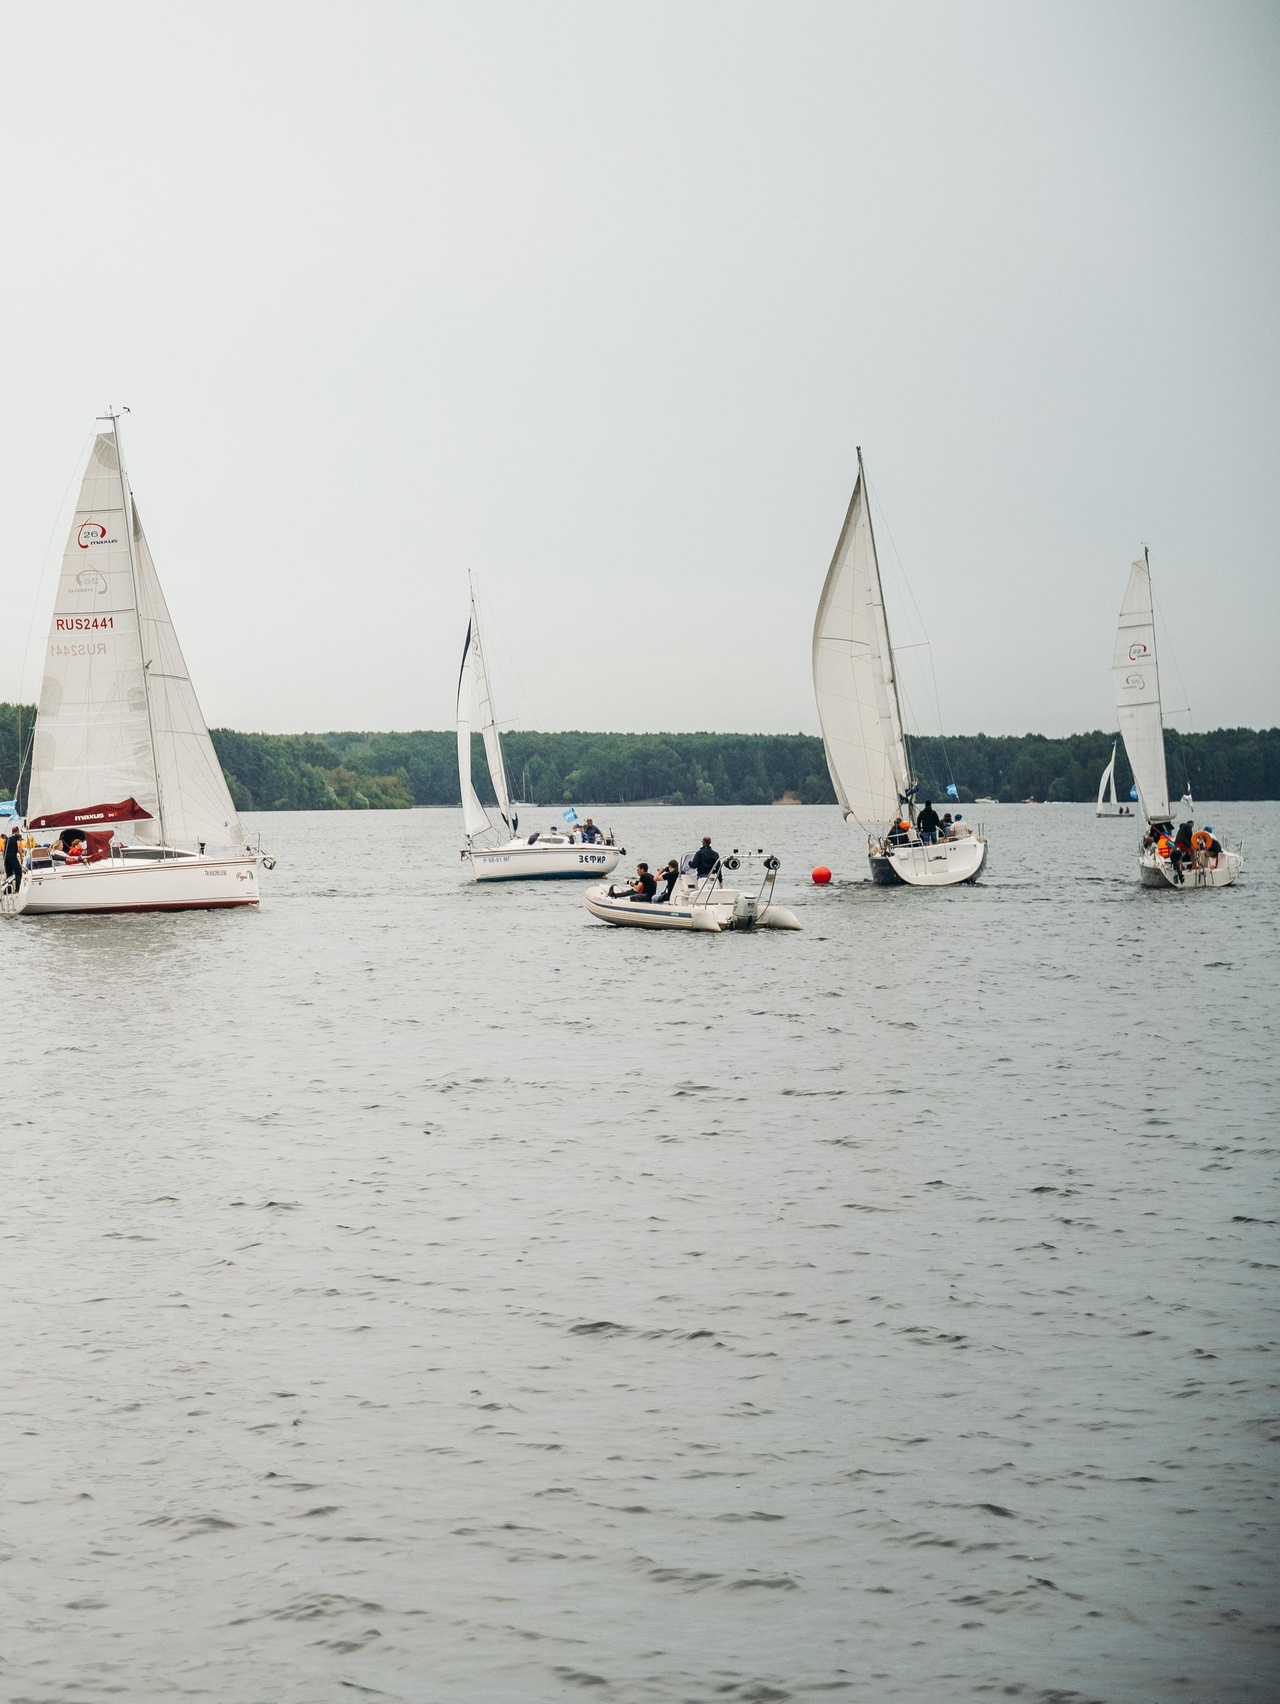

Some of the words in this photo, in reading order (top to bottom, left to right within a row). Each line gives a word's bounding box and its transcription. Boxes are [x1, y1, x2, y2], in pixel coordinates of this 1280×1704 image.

[83, 531, 99, 539] 26
[90, 538, 118, 546] maxus
[56, 617, 114, 631] RUS2441
[74, 813, 104, 821] maxus
[578, 855, 606, 864] ЗЕФИР
